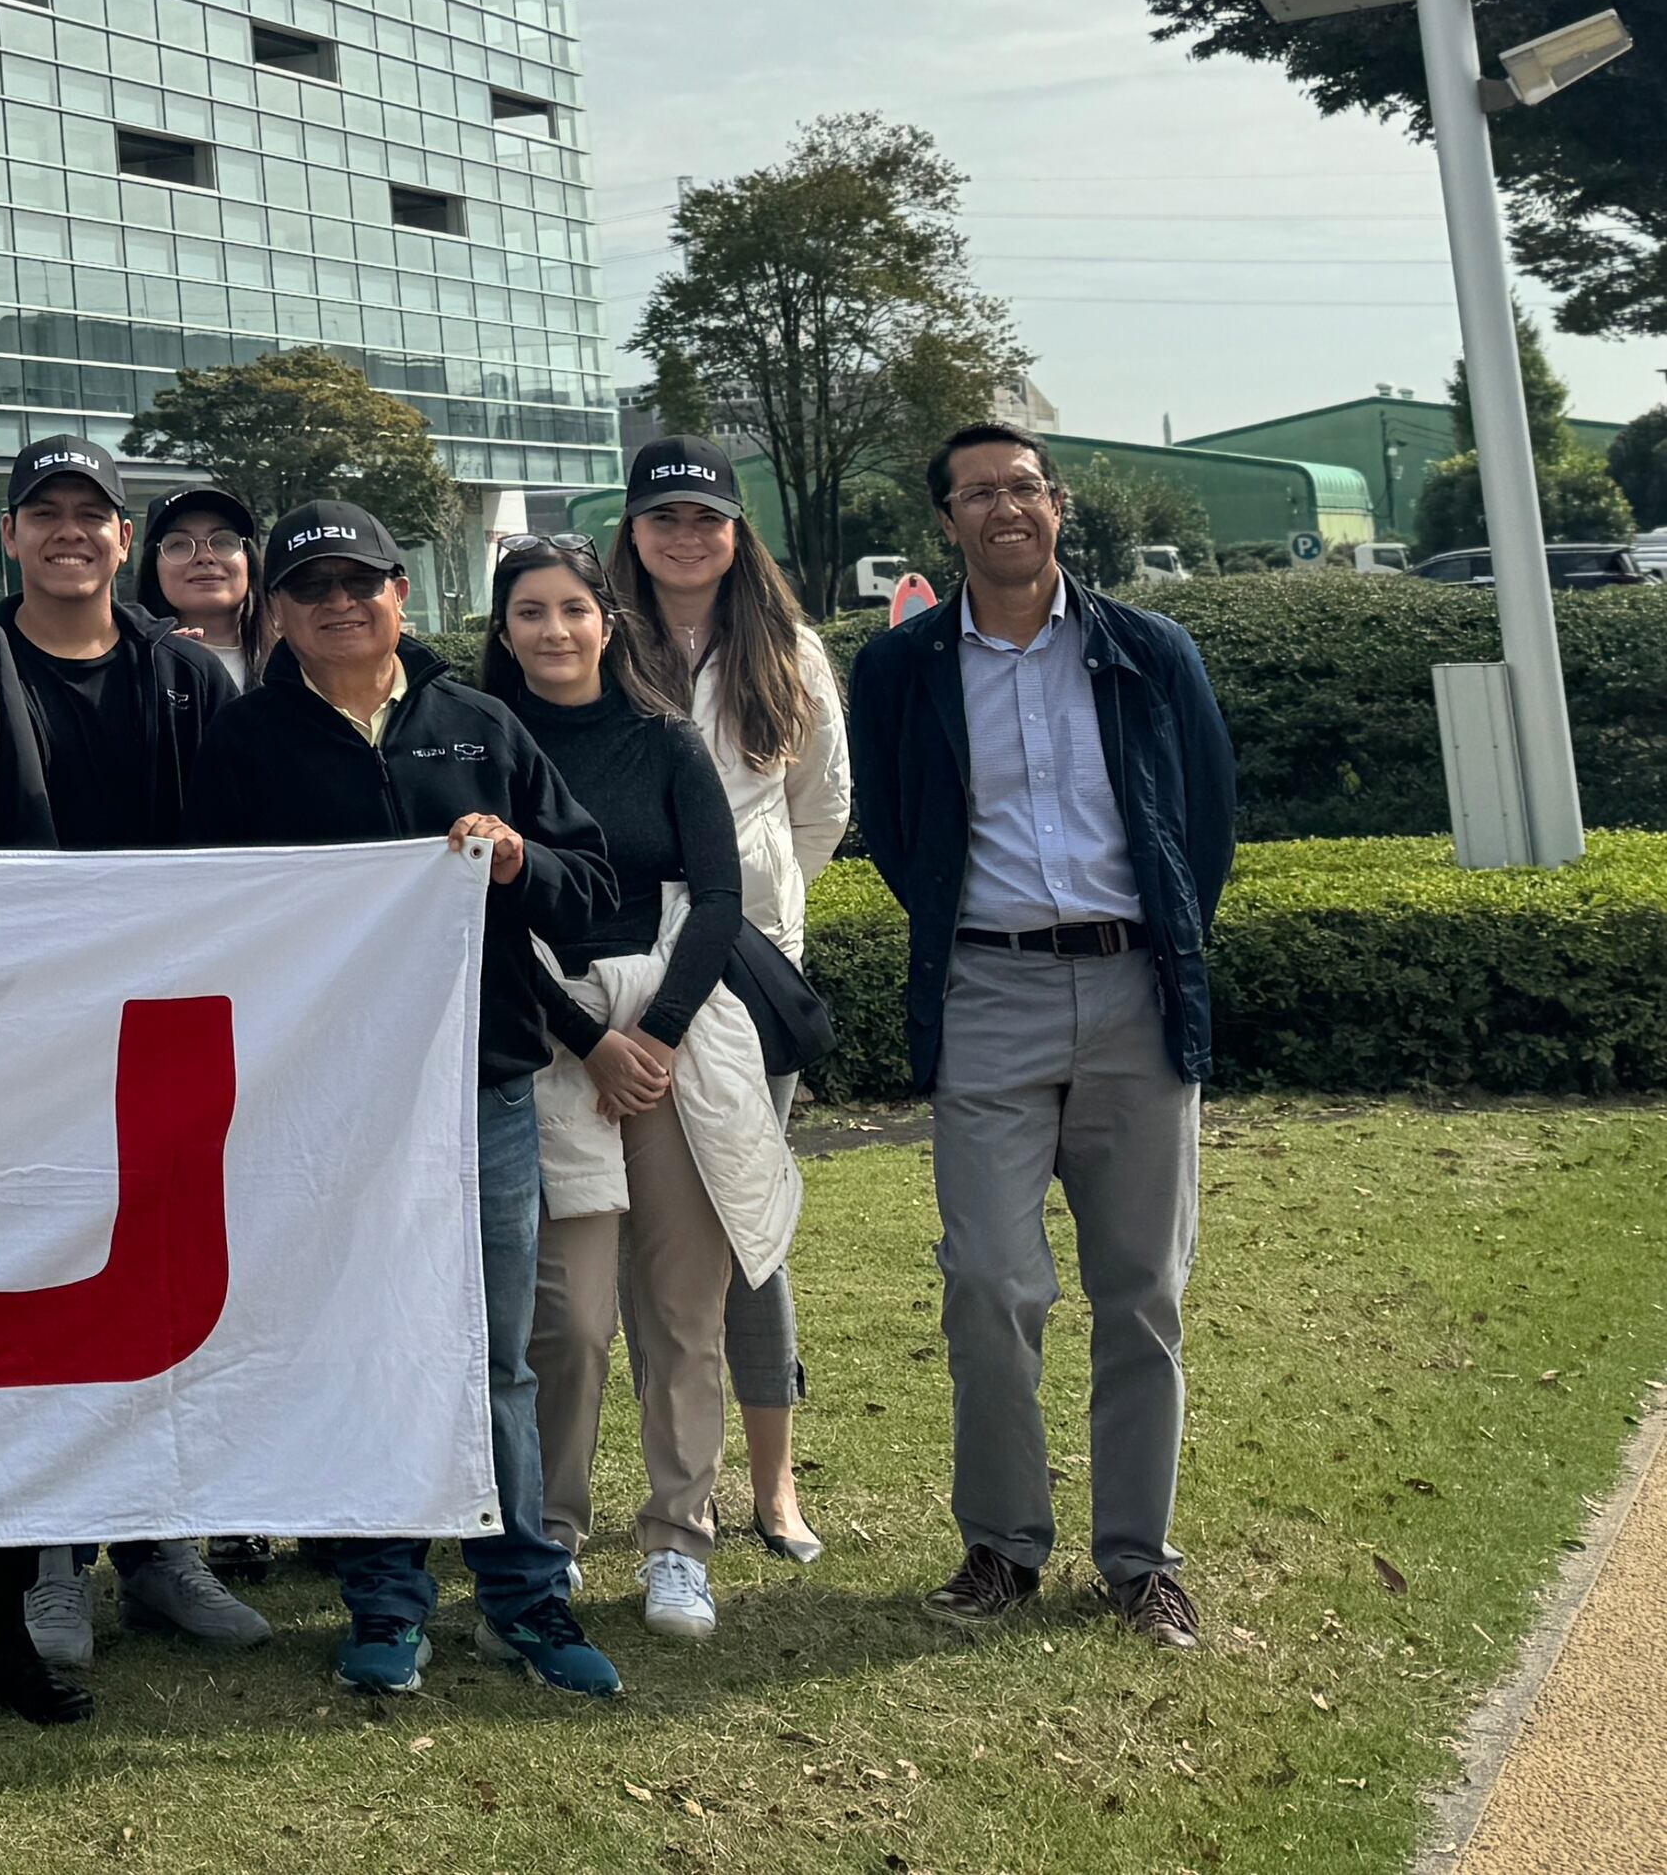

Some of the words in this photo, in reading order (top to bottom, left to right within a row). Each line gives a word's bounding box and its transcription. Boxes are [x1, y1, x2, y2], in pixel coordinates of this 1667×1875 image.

[34, 451, 99, 470] ISUZU
[651, 463, 716, 482] ISUZU
[287, 526, 357, 551] ISUZU
[411, 747, 446, 758] ISUZU
